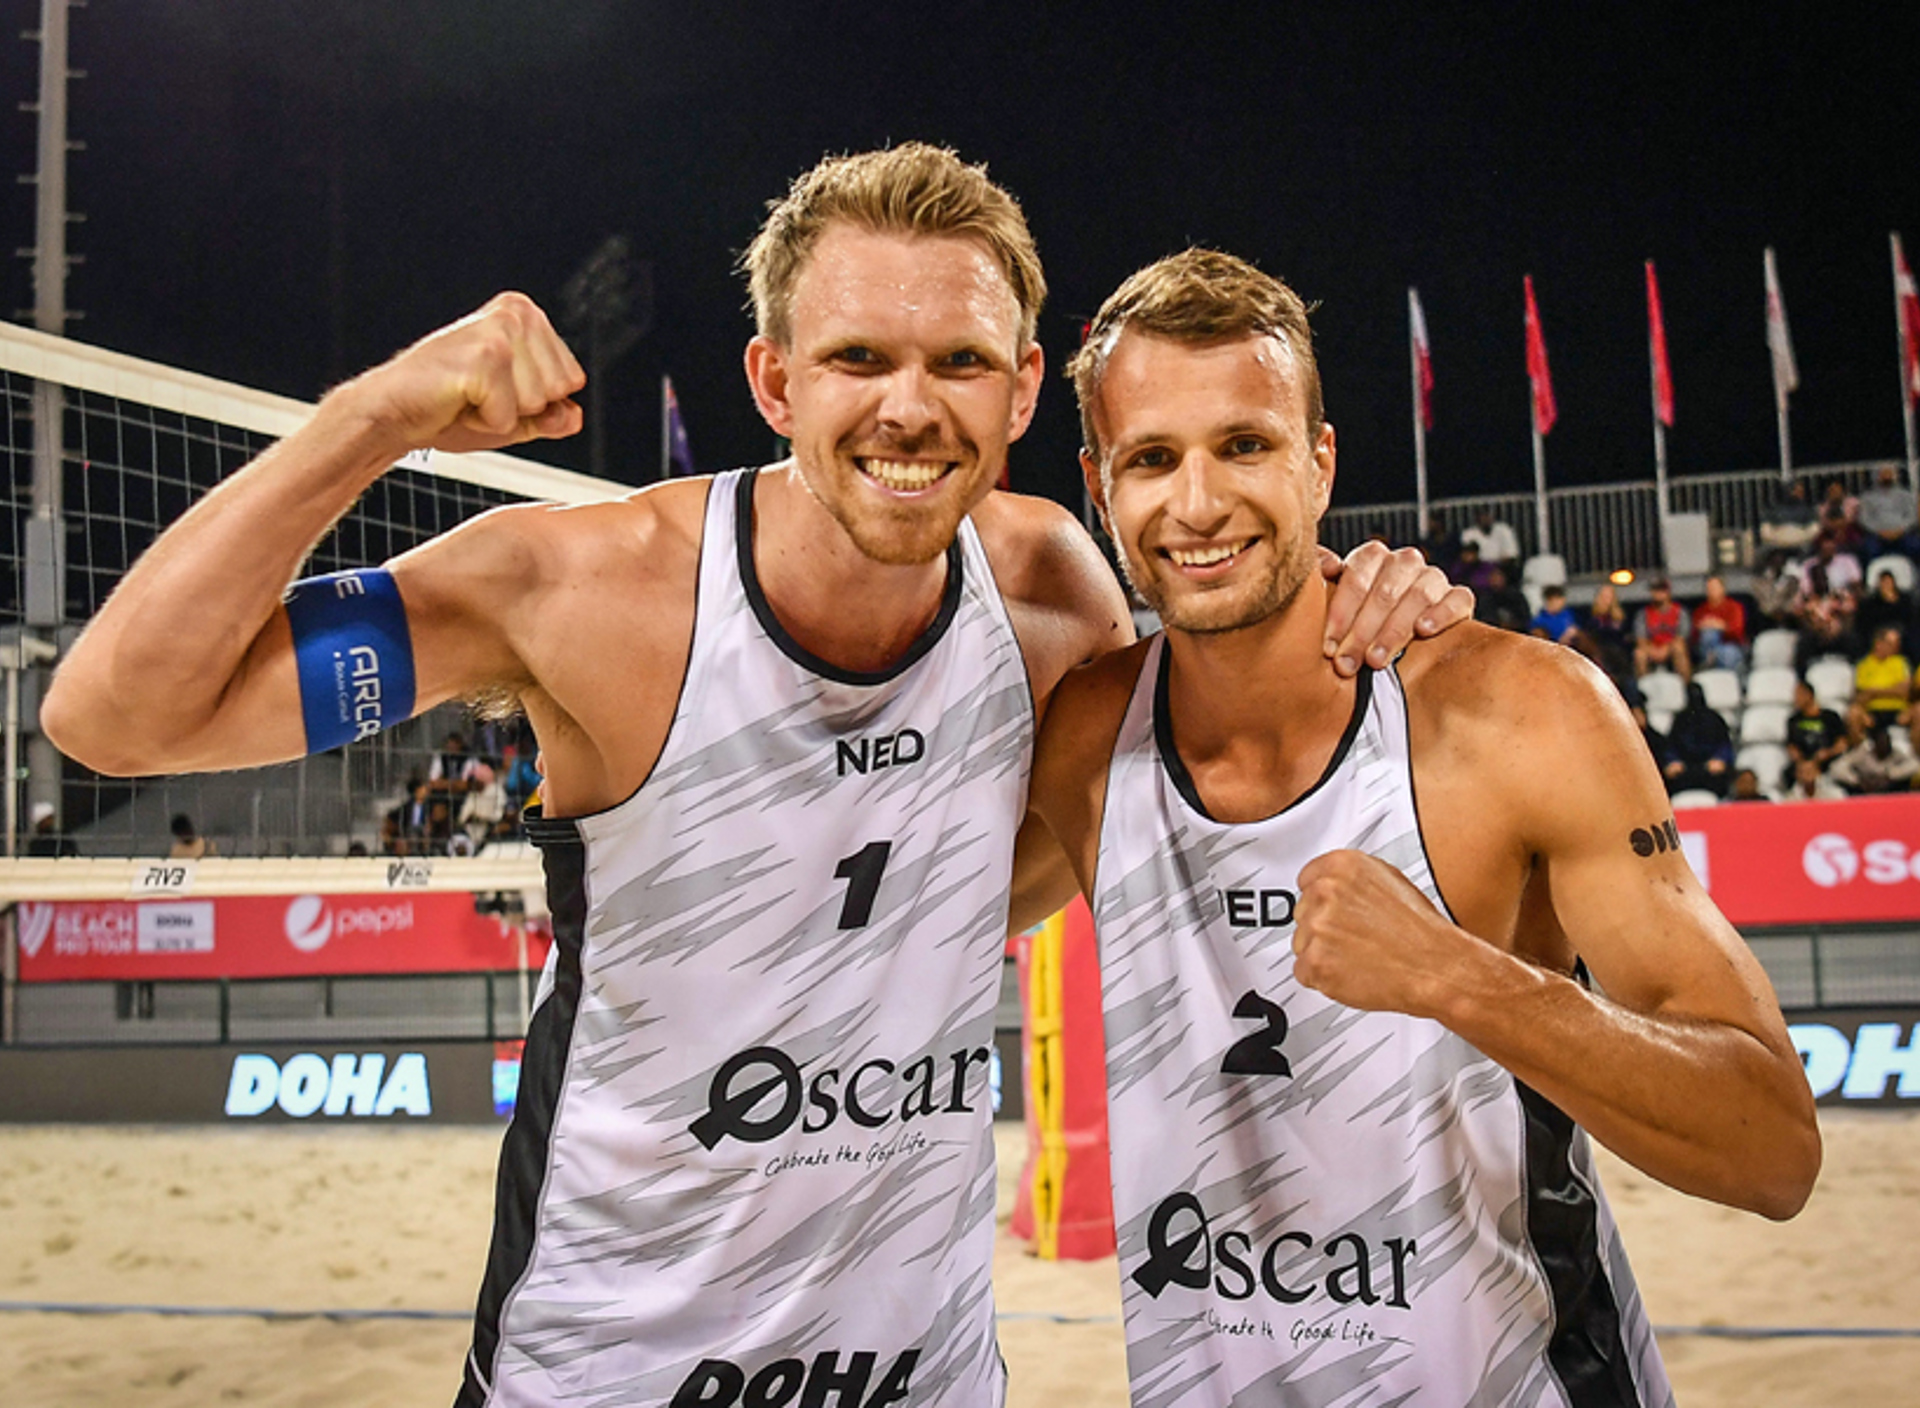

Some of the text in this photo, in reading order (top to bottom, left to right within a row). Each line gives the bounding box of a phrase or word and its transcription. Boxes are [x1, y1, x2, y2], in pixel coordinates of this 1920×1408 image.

[836, 728, 925, 777] NED
[833, 840, 892, 930] 1
[1218, 889, 1296, 928] ED
[336, 900, 414, 938] pepsi
[1221, 989, 1293, 1079] 2
[225, 1053, 431, 1116] DOHA
[836, 1145, 859, 1162] the
[899, 1131, 925, 1155] Life
[1290, 1319, 1336, 1349] Good
[1342, 1319, 1375, 1347] Life
[668, 1350, 922, 1408] DOHA
